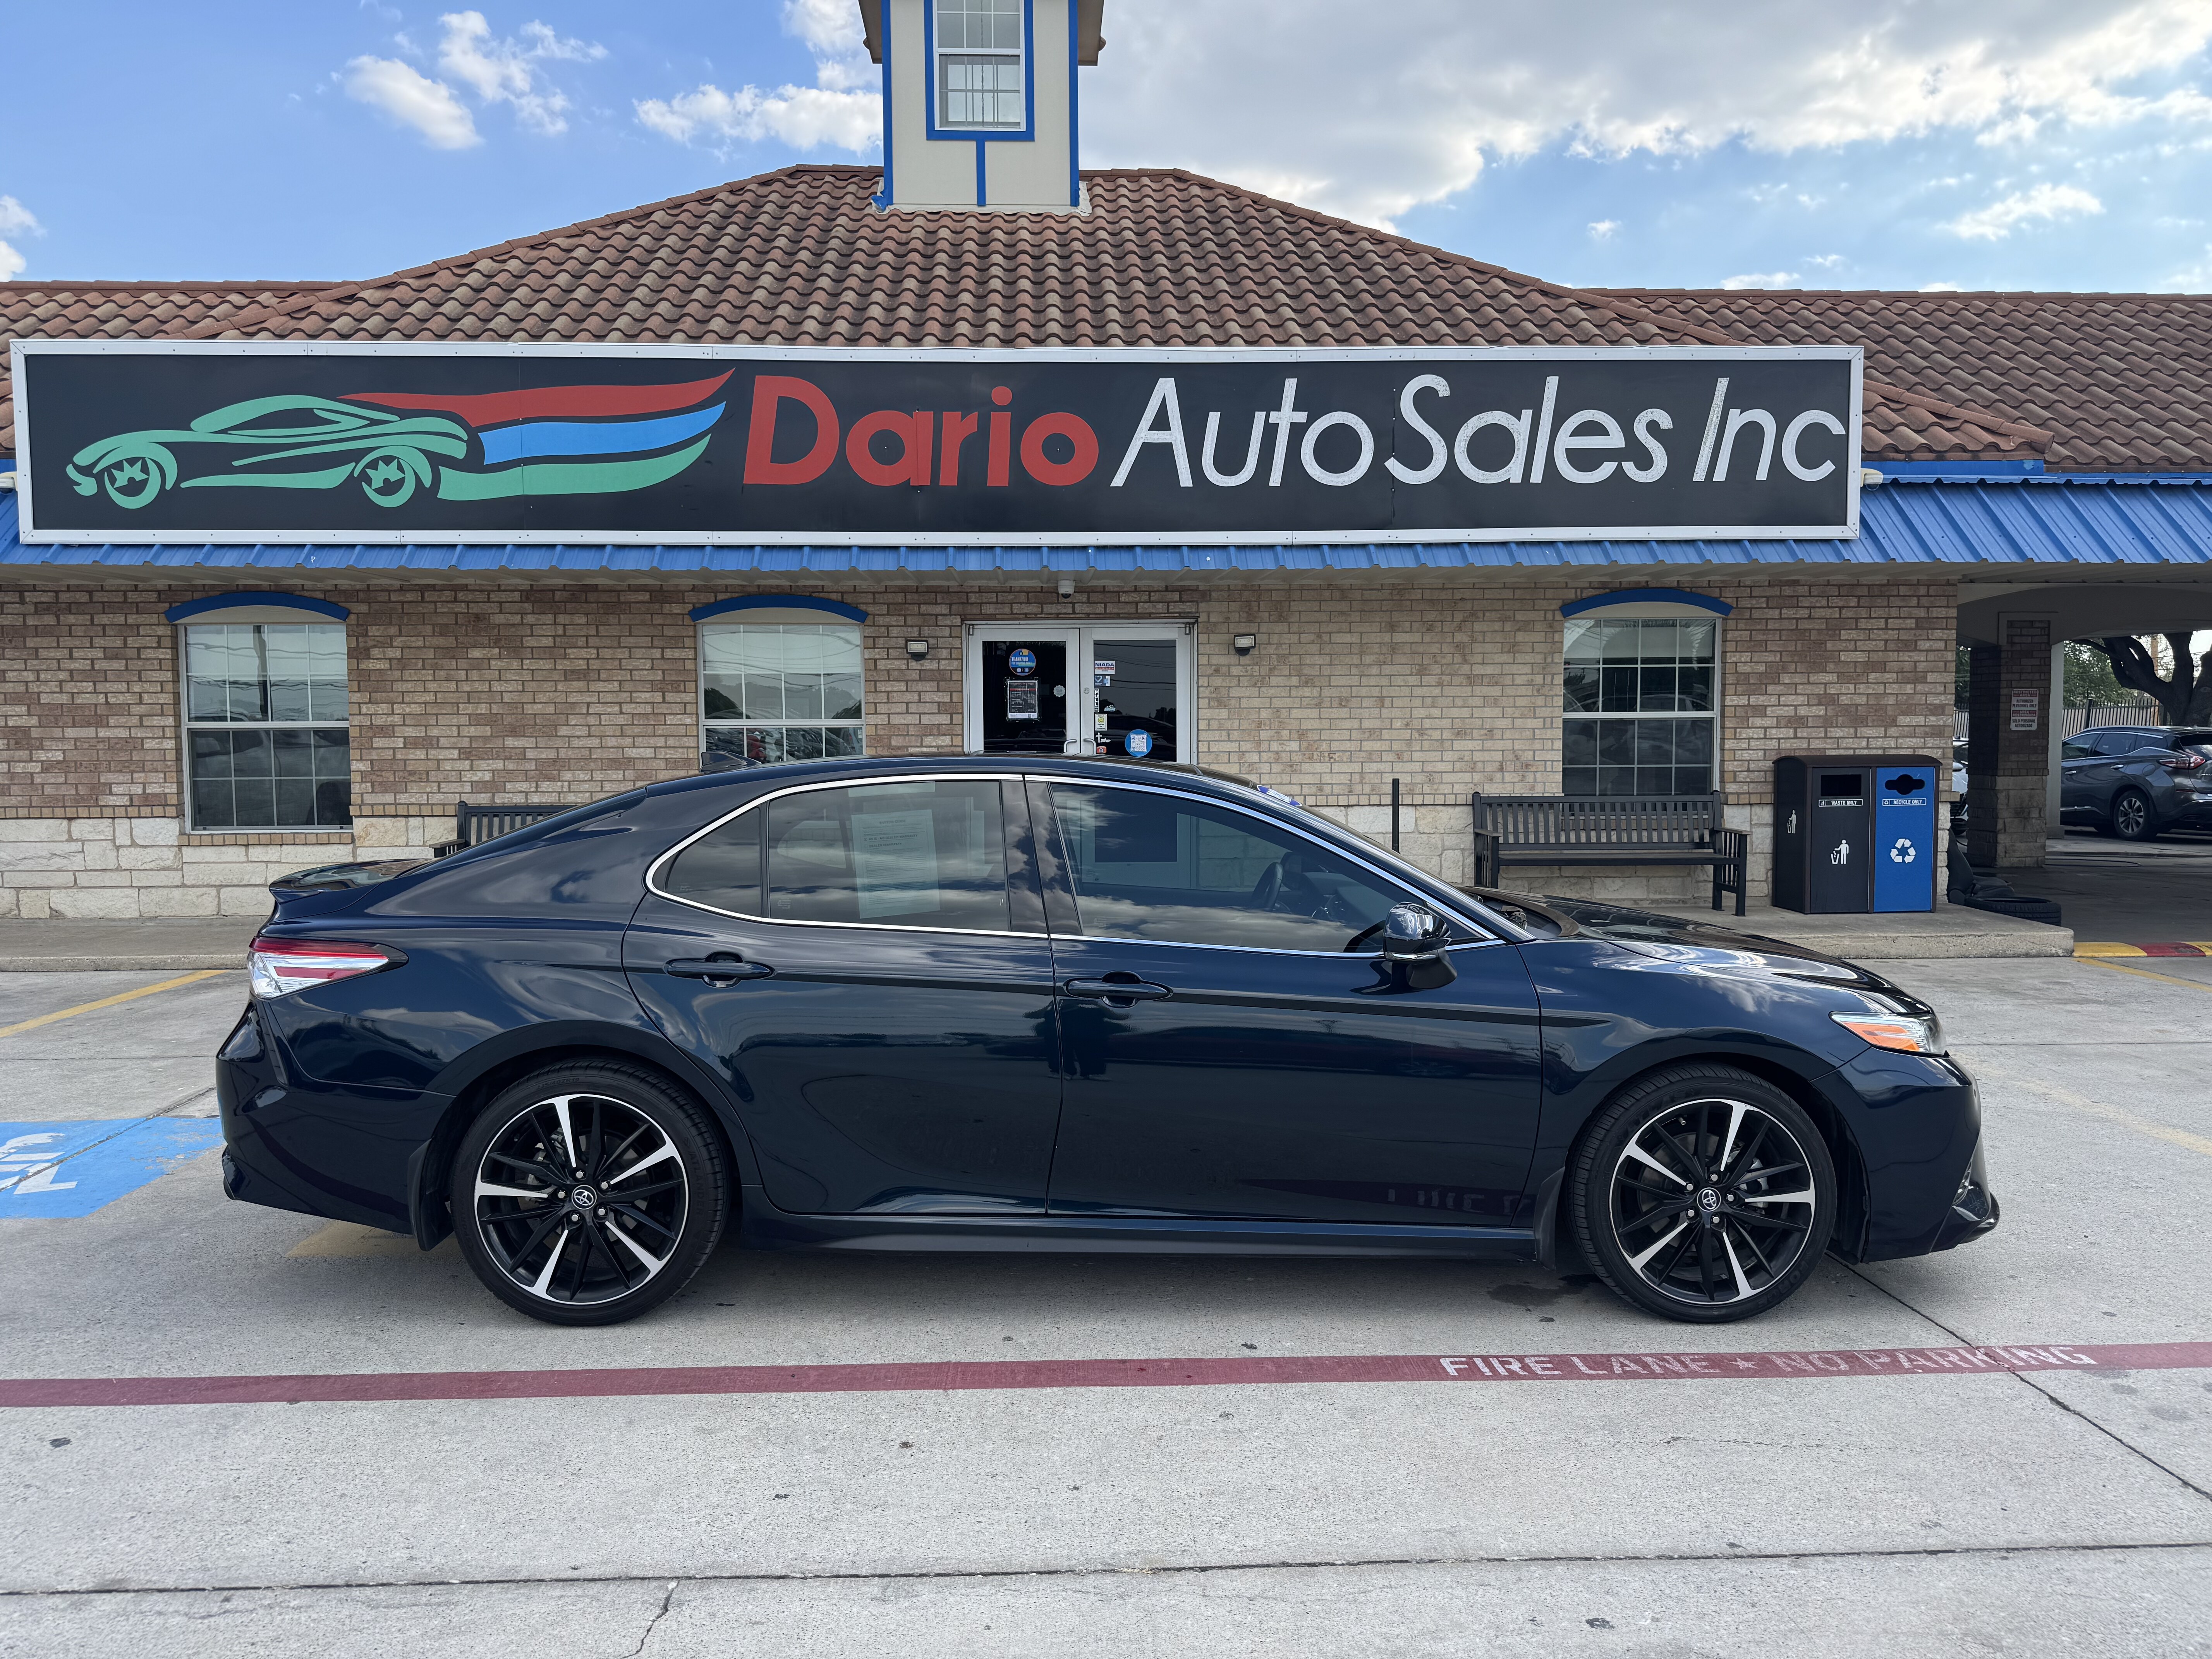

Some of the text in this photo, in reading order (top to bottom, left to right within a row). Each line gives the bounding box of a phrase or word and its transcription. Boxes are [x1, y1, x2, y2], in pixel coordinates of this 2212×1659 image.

[744, 374, 1844, 487] Dario Auto Sales Inc
[1439, 1346, 2097, 1376] FIRE LANE NO PARKING
